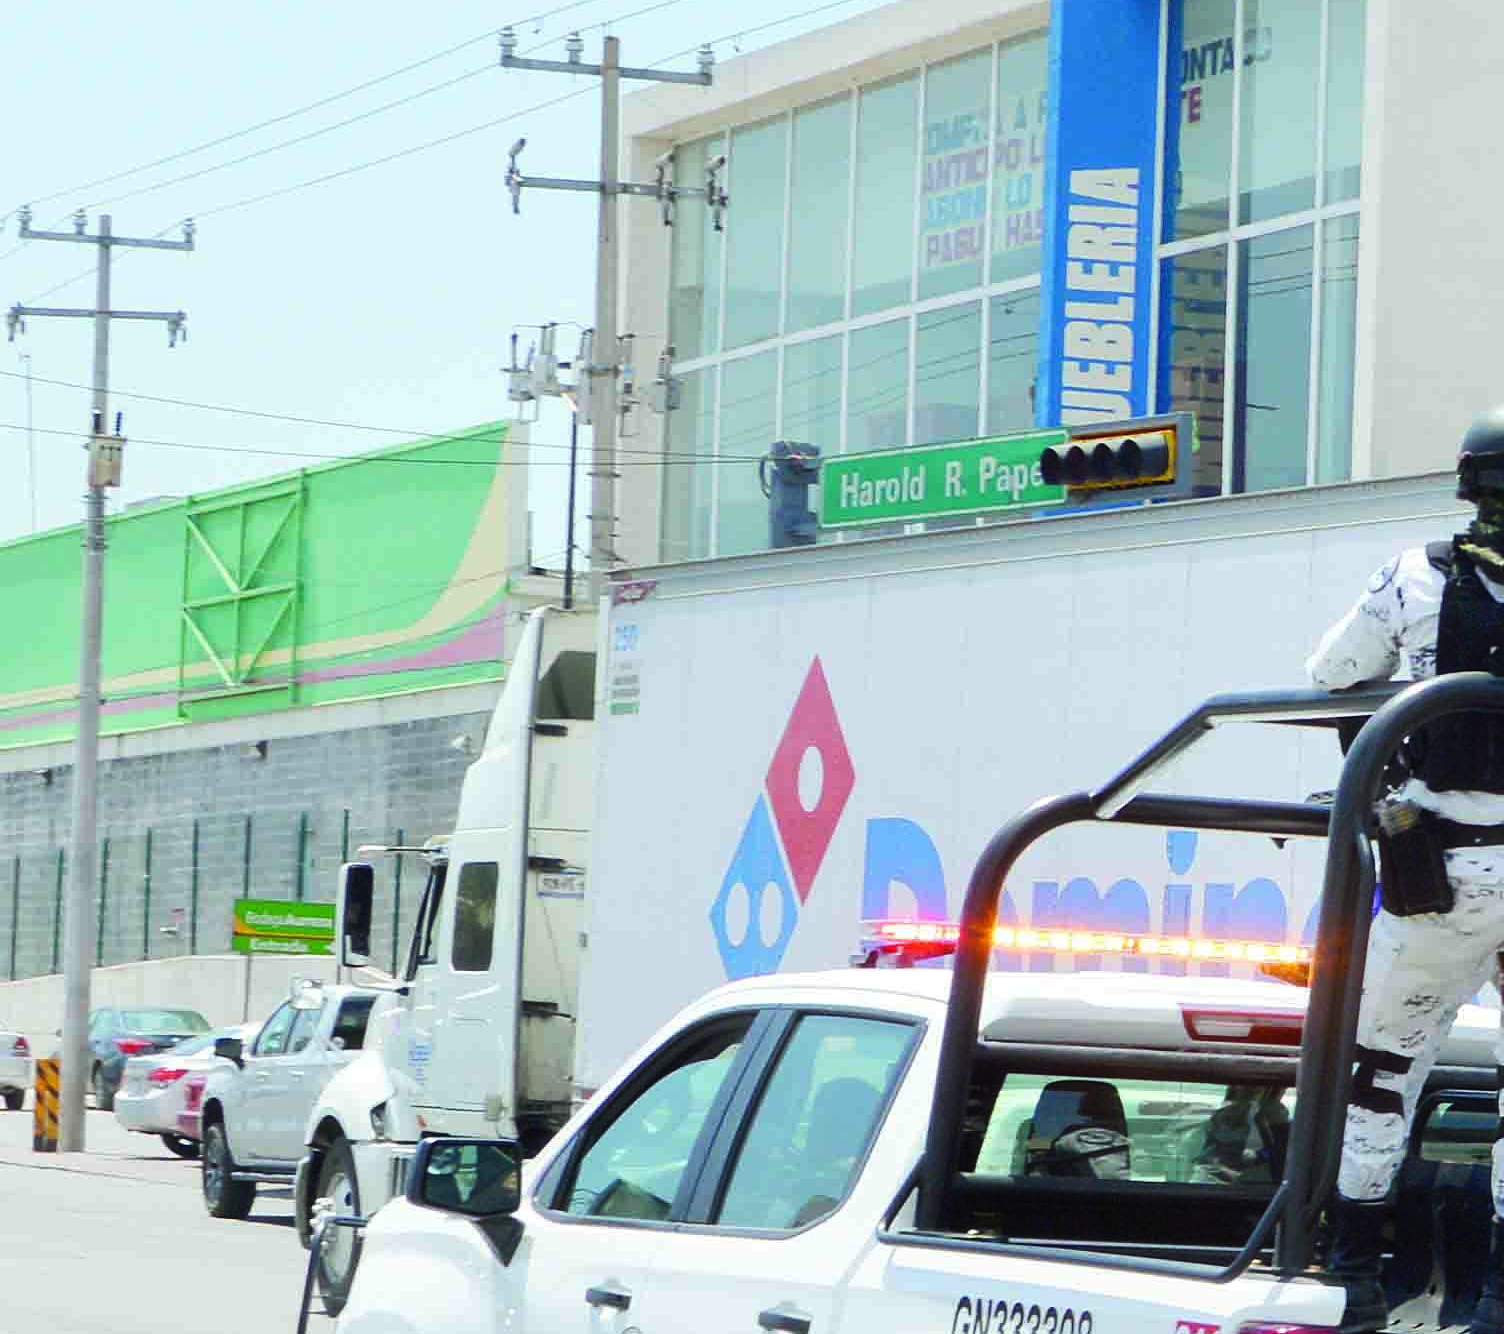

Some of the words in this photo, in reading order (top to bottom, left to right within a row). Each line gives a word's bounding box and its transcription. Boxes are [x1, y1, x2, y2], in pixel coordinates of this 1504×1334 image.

[1059, 167, 1140, 429] UEBLERIA
[839, 464, 927, 508] Harold
[944, 460, 968, 498] R.
[978, 455, 1044, 501] Pape
